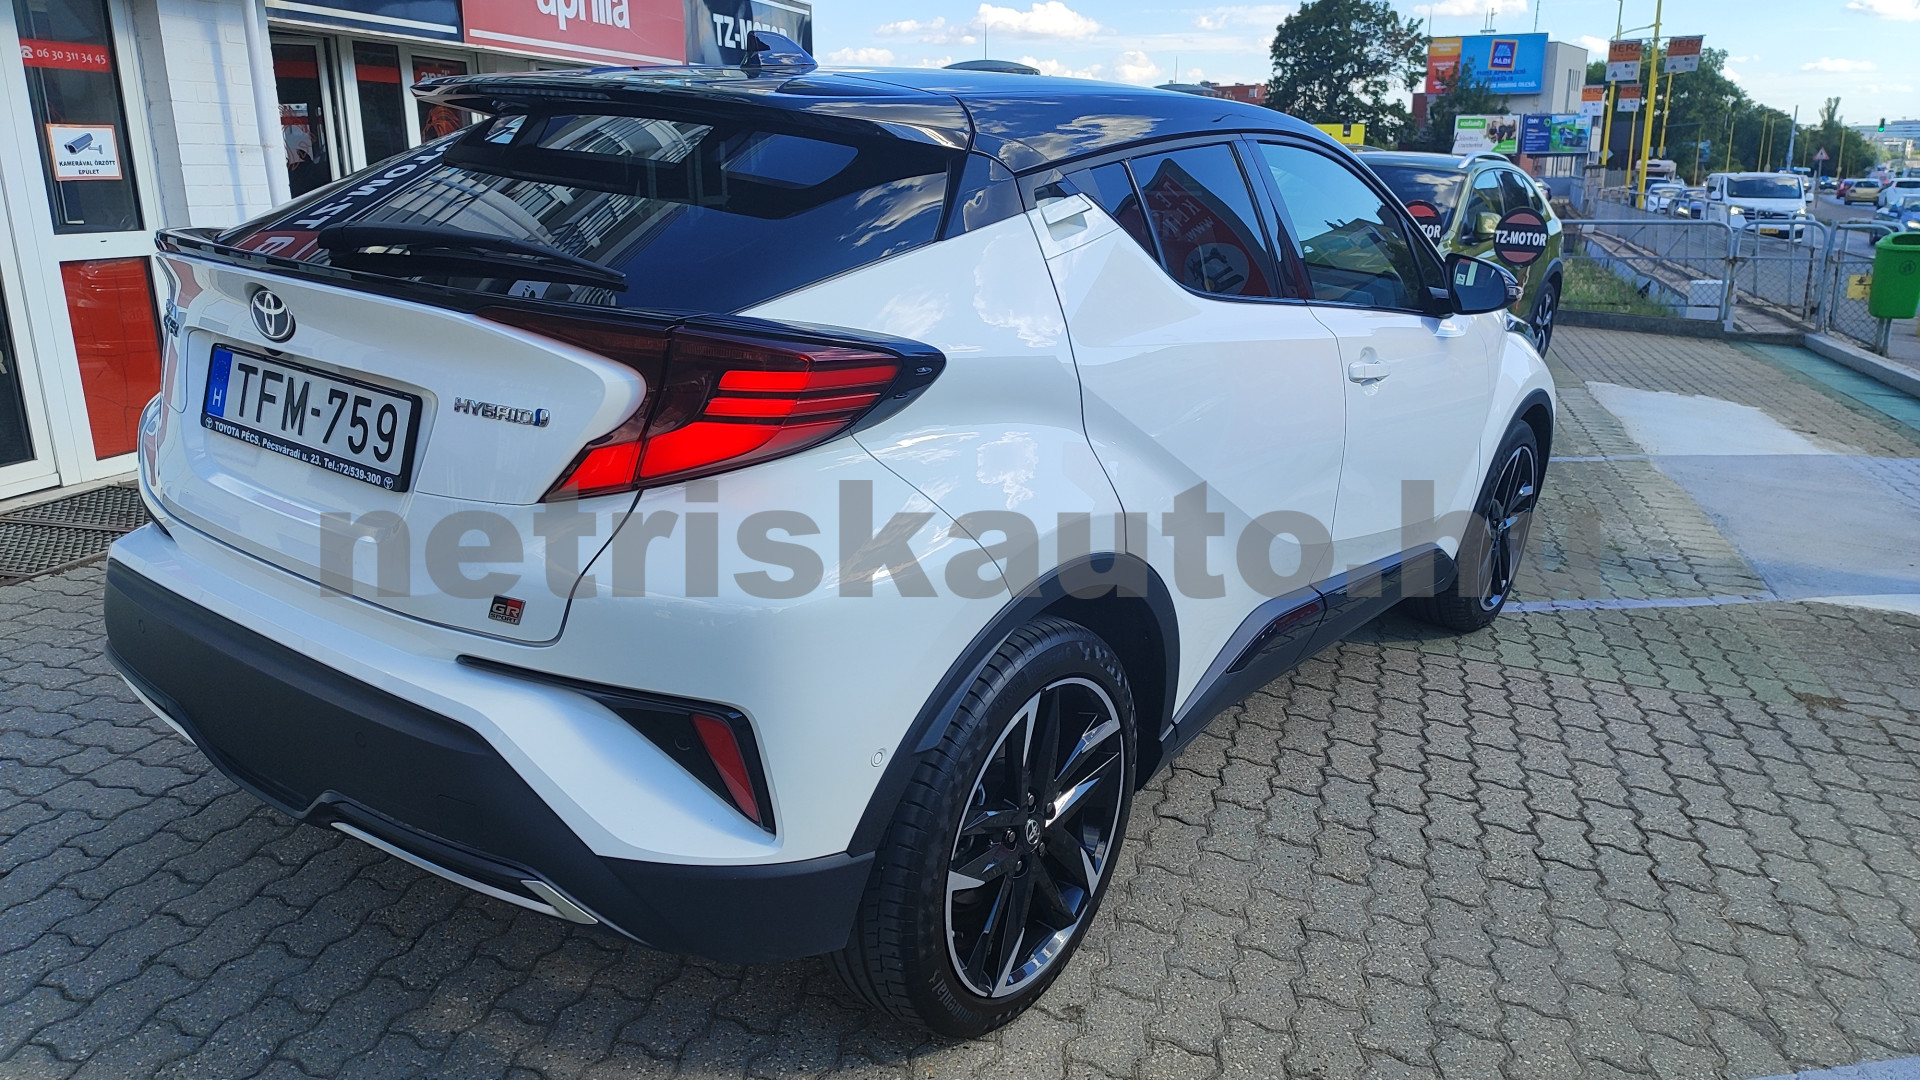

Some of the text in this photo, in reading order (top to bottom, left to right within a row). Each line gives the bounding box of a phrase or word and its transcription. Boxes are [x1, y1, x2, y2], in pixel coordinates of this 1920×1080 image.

[712, 13, 788, 50] TZ-M
[36, 48, 106, 65] 06 30 311 34 45
[1495, 230, 1547, 247] TZ-MOTOR
[212, 388, 223, 408] H
[237, 363, 398, 463] TFM-759
[454, 397, 534, 425] HYBRID
[214, 421, 382, 485] TOYOTA PÉCS, Pécsváradi u. 23. Tel.:72/539-300
[490, 612, 518, 623] SPORT
[492, 603, 520, 618] GR
